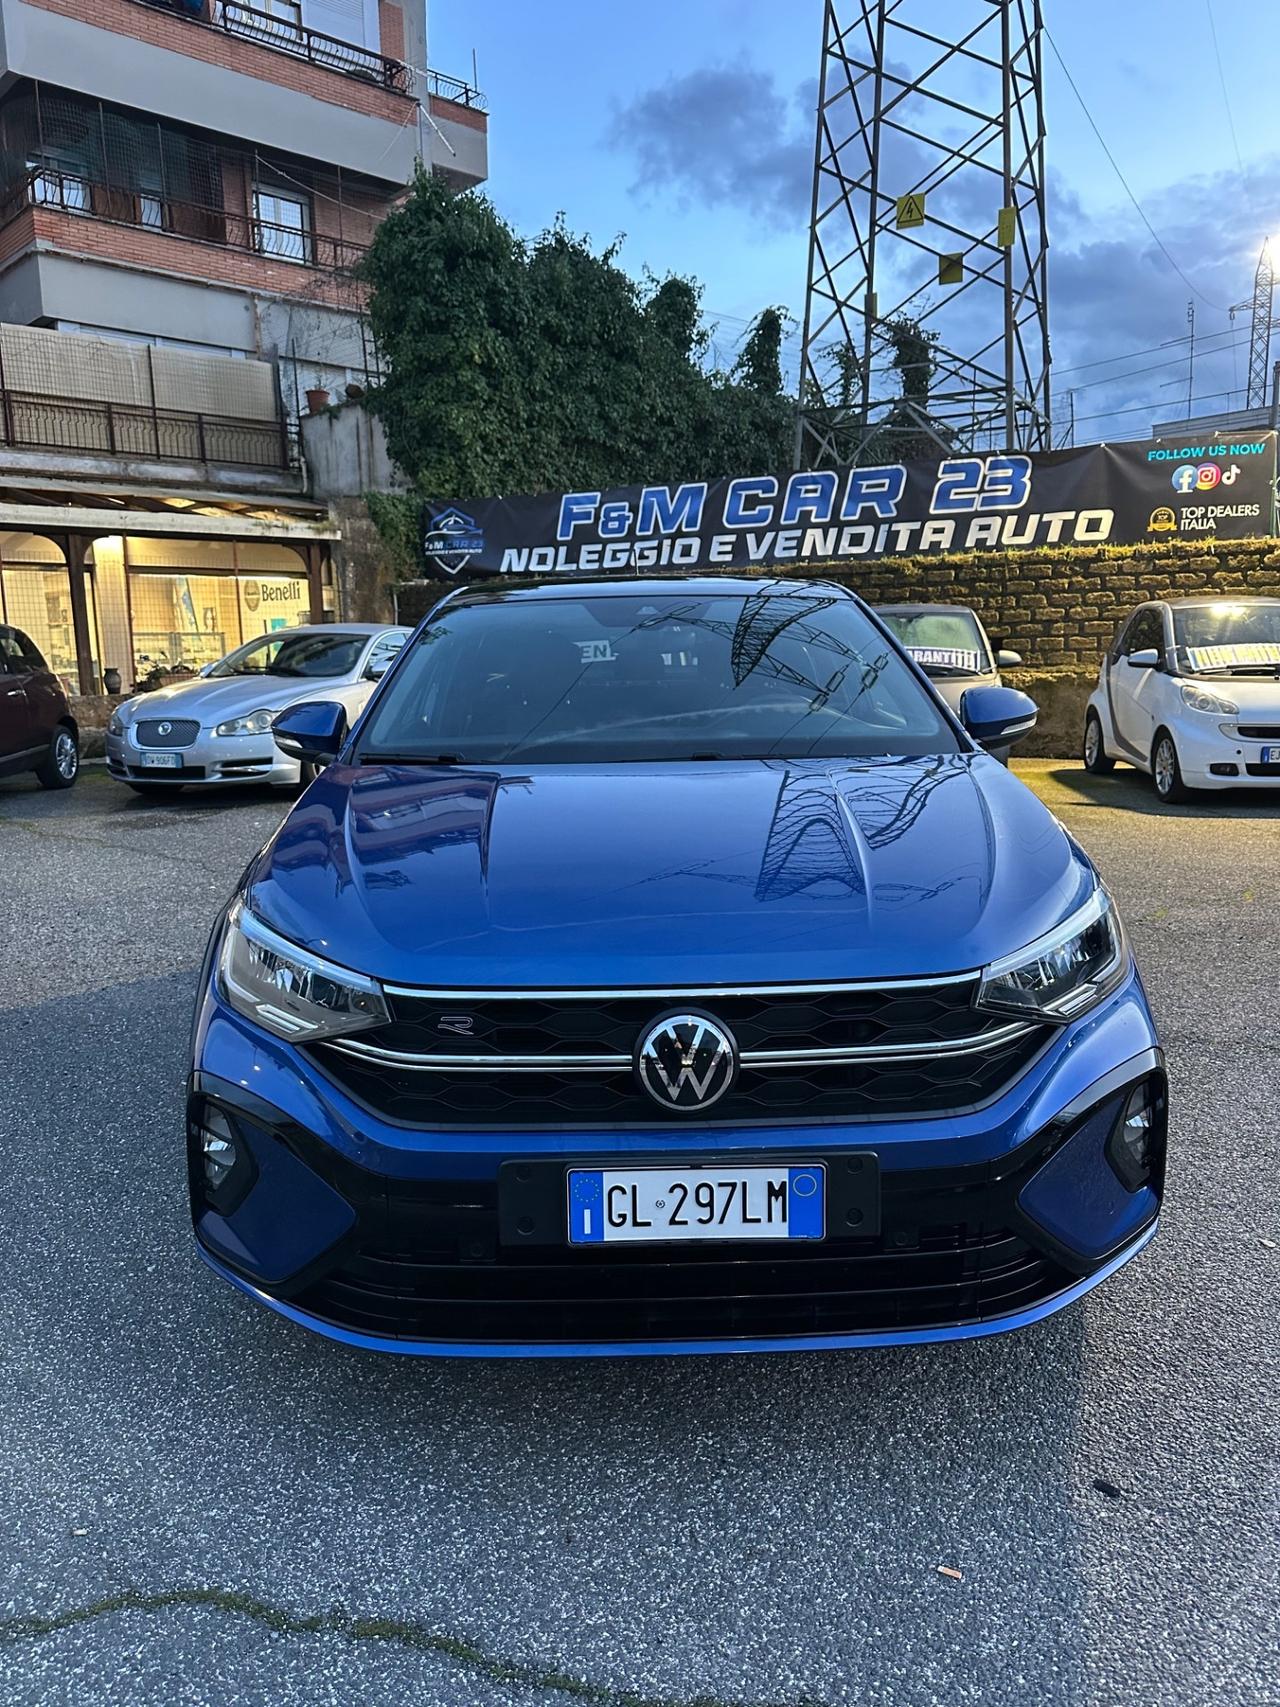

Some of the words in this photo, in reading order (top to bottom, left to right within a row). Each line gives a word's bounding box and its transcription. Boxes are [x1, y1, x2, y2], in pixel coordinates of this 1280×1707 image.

[1148, 446, 1206, 461] FOLLOW
[1208, 445, 1227, 457] US
[1229, 443, 1266, 455] NOW
[556, 482, 708, 541] F&M
[722, 464, 907, 529] CAR
[929, 455, 1033, 514] 23
[1181, 506, 1206, 519] TOP
[1207, 504, 1260, 518] DEALERS
[1180, 518, 1217, 530] ITALIA
[500, 537, 702, 573] NOLEGGIO
[709, 534, 737, 562] E
[746, 519, 956, 560] VENDITA
[965, 509, 1115, 547] AUTO
[261, 581, 301, 601] Benelli
[607, 1184, 652, 1228] GL
[668, 1180, 788, 1226] 297LM
